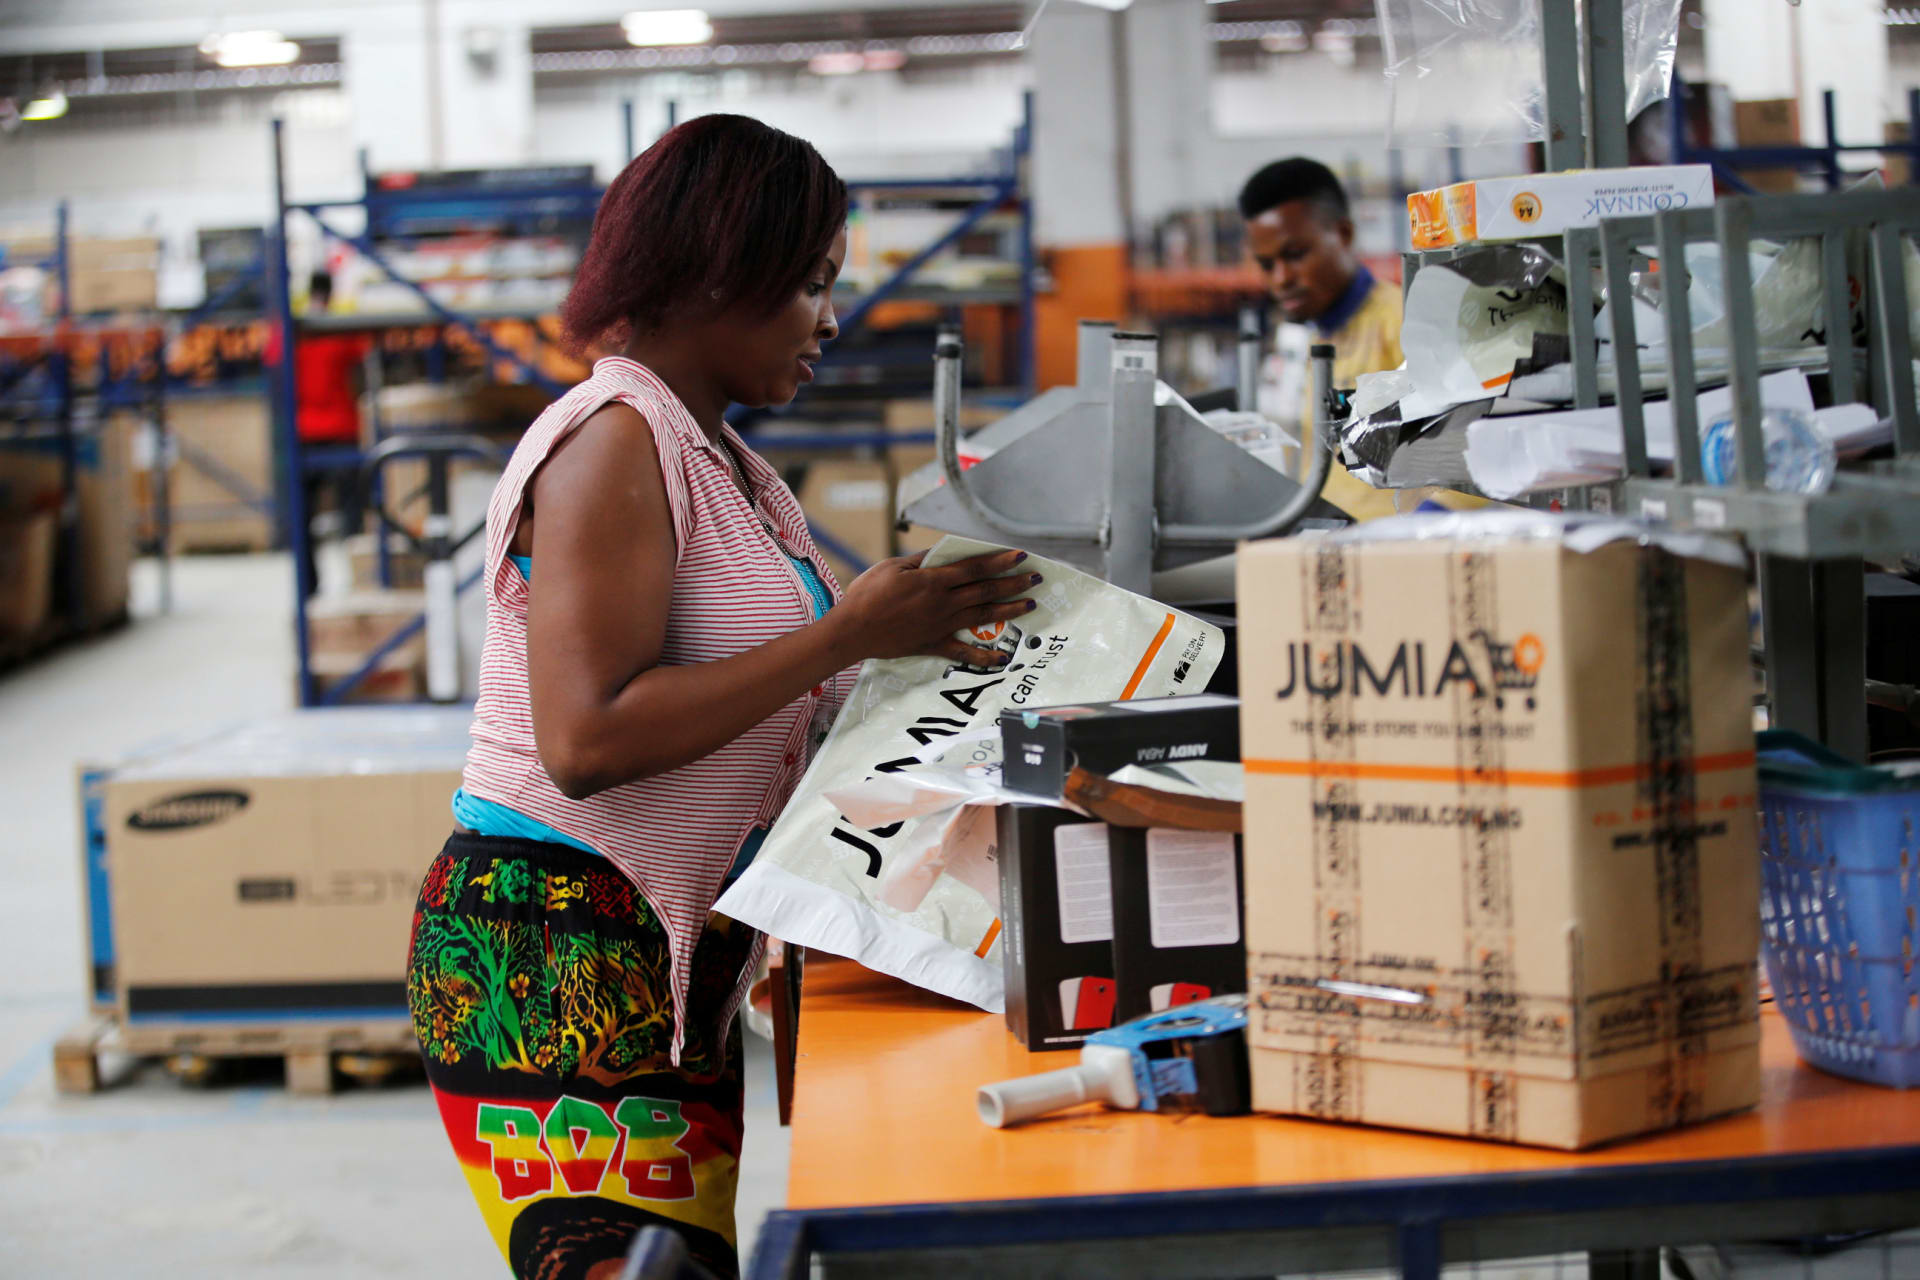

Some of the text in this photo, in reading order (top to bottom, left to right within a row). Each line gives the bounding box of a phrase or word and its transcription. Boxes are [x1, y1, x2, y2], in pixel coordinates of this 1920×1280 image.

[1585, 191, 1689, 215] CONNAK
[1189, 631, 1207, 662] DELIVERY
[1011, 674, 1039, 704] can
[1030, 635, 1069, 669] trust
[1277, 641, 1485, 699] JUMIA
[1291, 719, 1313, 734] THE
[1374, 721, 1418, 737] STORE
[1168, 743, 1209, 759] ANDY
[476, 1095, 697, 1201] BOB
